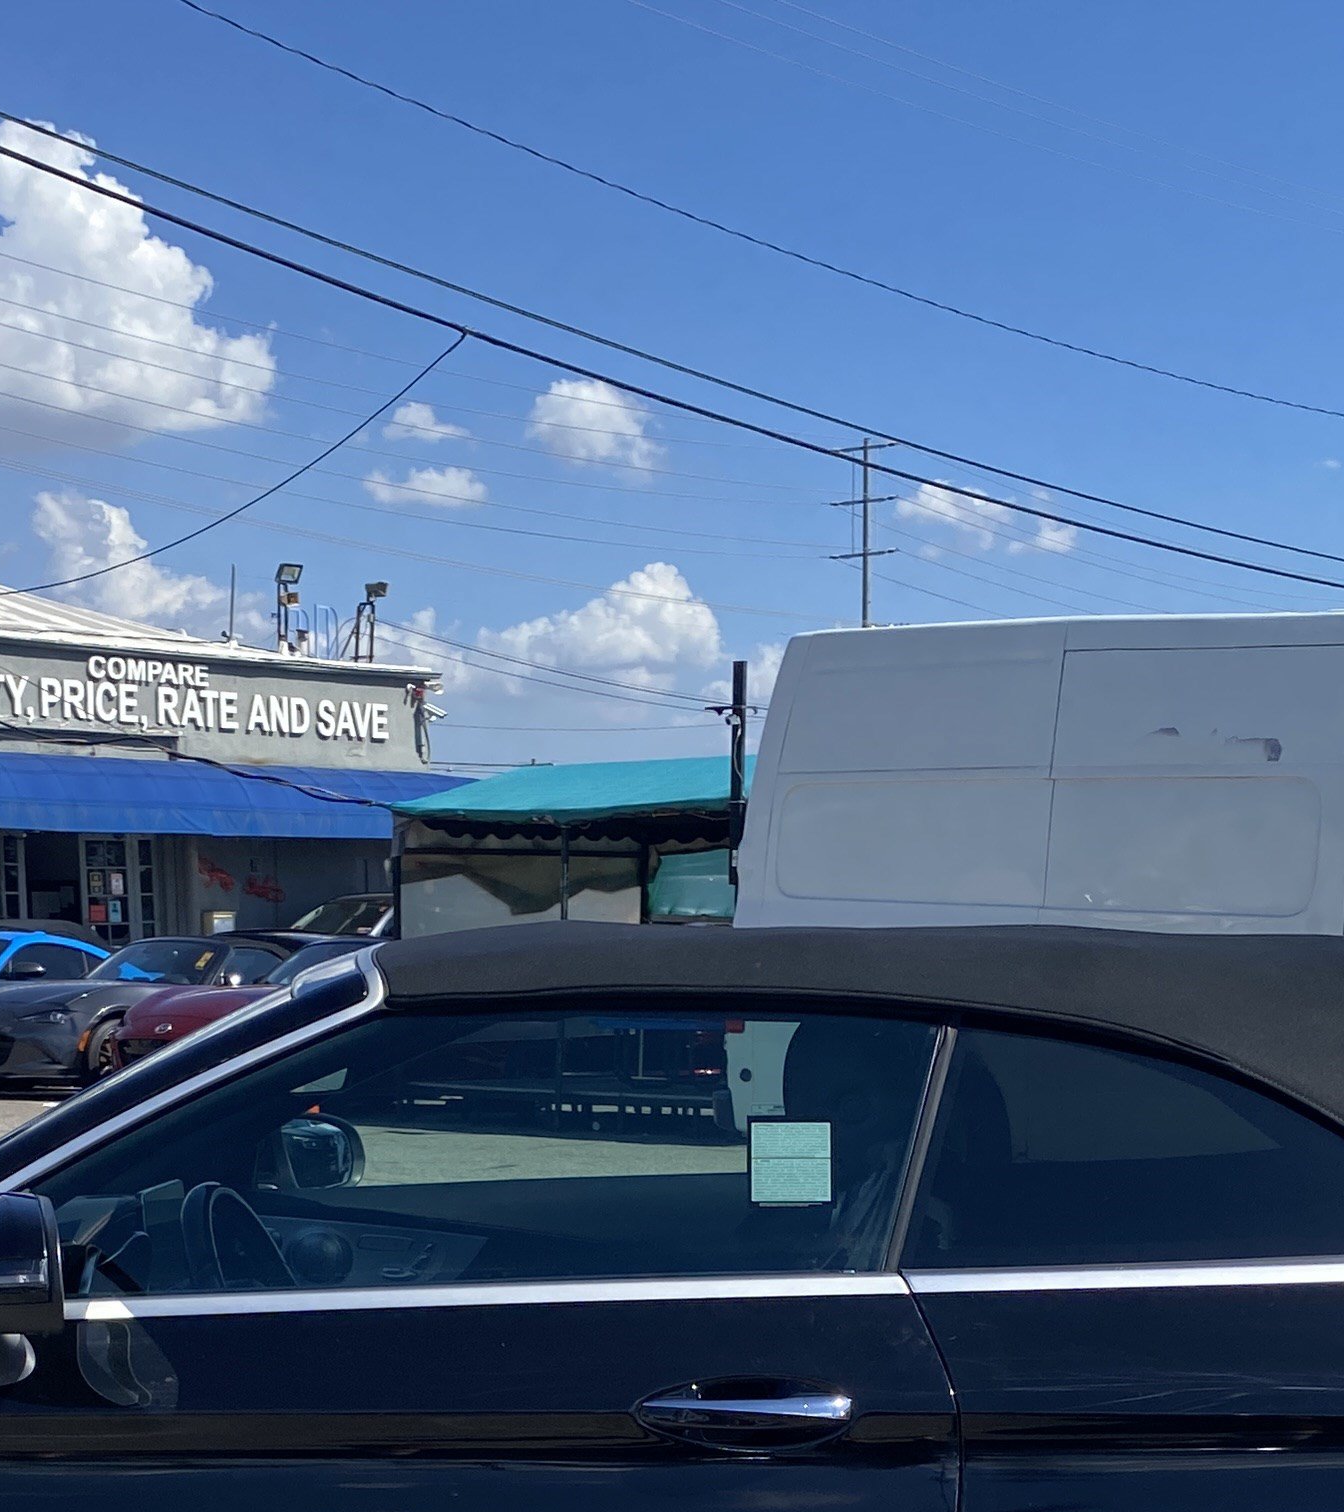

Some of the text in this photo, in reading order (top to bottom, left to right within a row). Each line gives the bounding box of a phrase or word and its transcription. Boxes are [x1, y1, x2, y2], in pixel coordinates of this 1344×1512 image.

[87, 655, 210, 688] COMPARE
[40, 677, 149, 731] PRICE,
[156, 686, 240, 729] RATE
[248, 694, 311, 734] AND
[316, 699, 390, 740] SAVE
